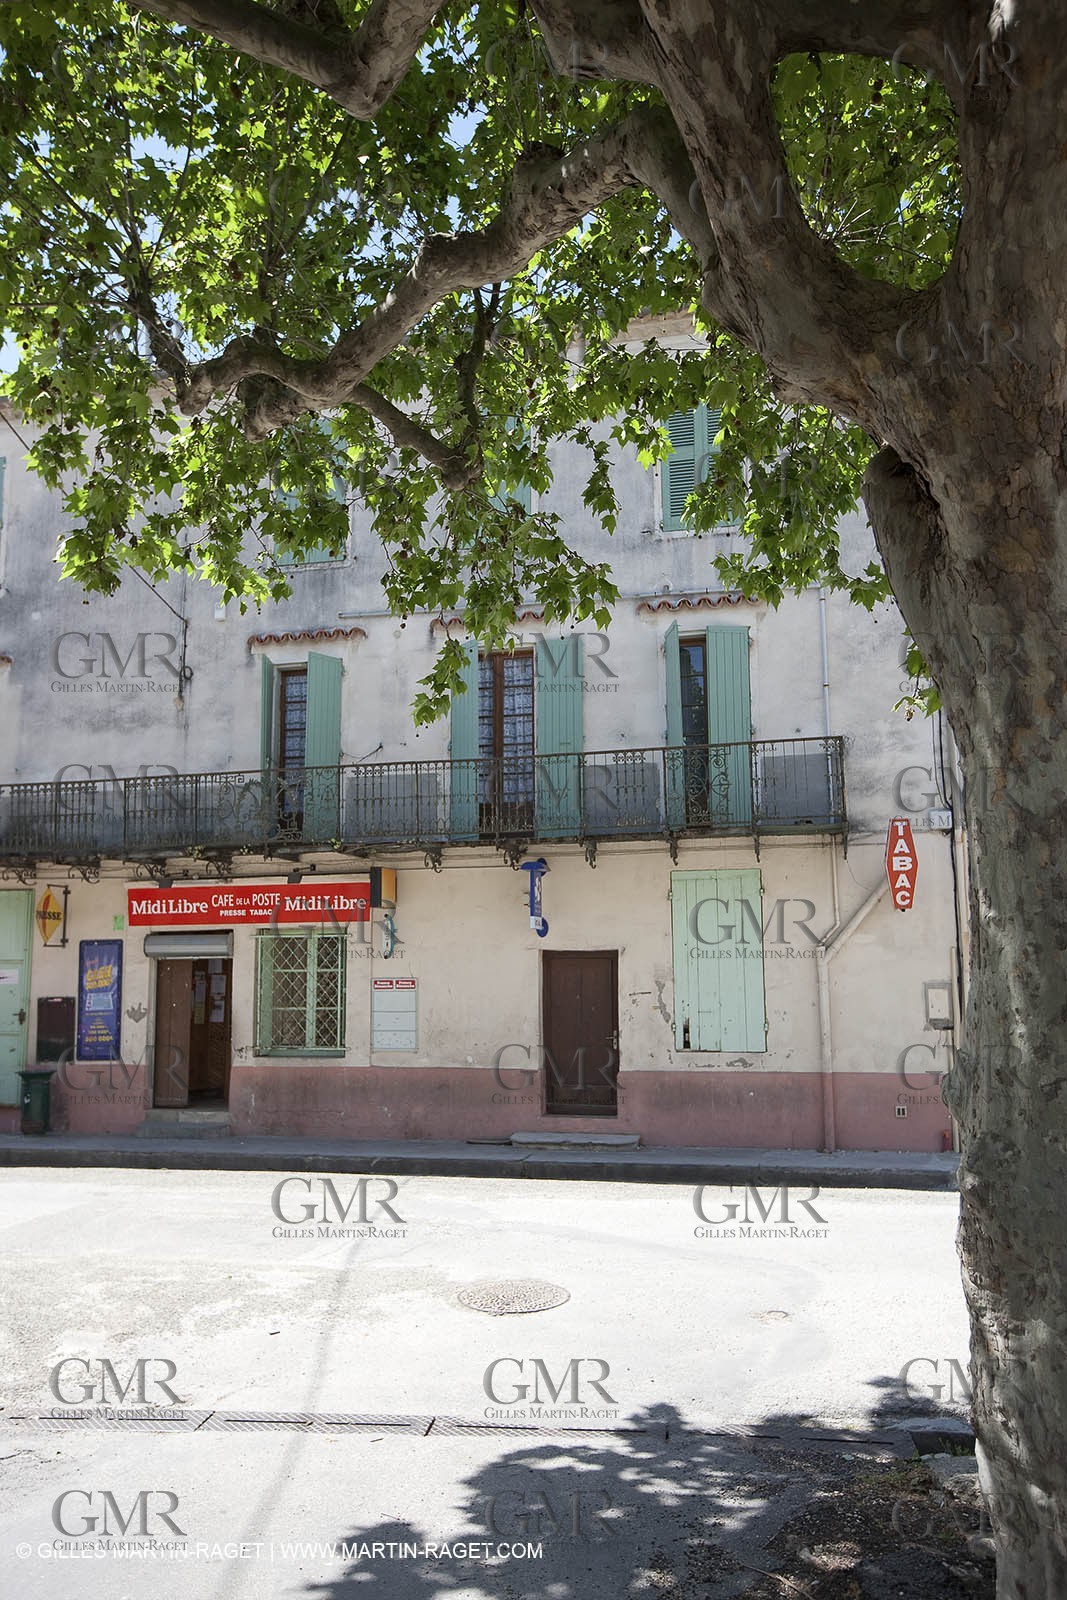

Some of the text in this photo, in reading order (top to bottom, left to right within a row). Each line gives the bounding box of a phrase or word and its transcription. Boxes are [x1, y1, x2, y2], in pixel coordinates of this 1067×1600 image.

[892, 820, 913, 906] TABAC
[211, 894, 235, 908] CAFE
[251, 893, 281, 906] POSTE
[219, 908, 273, 917] PRESSE TABAC
